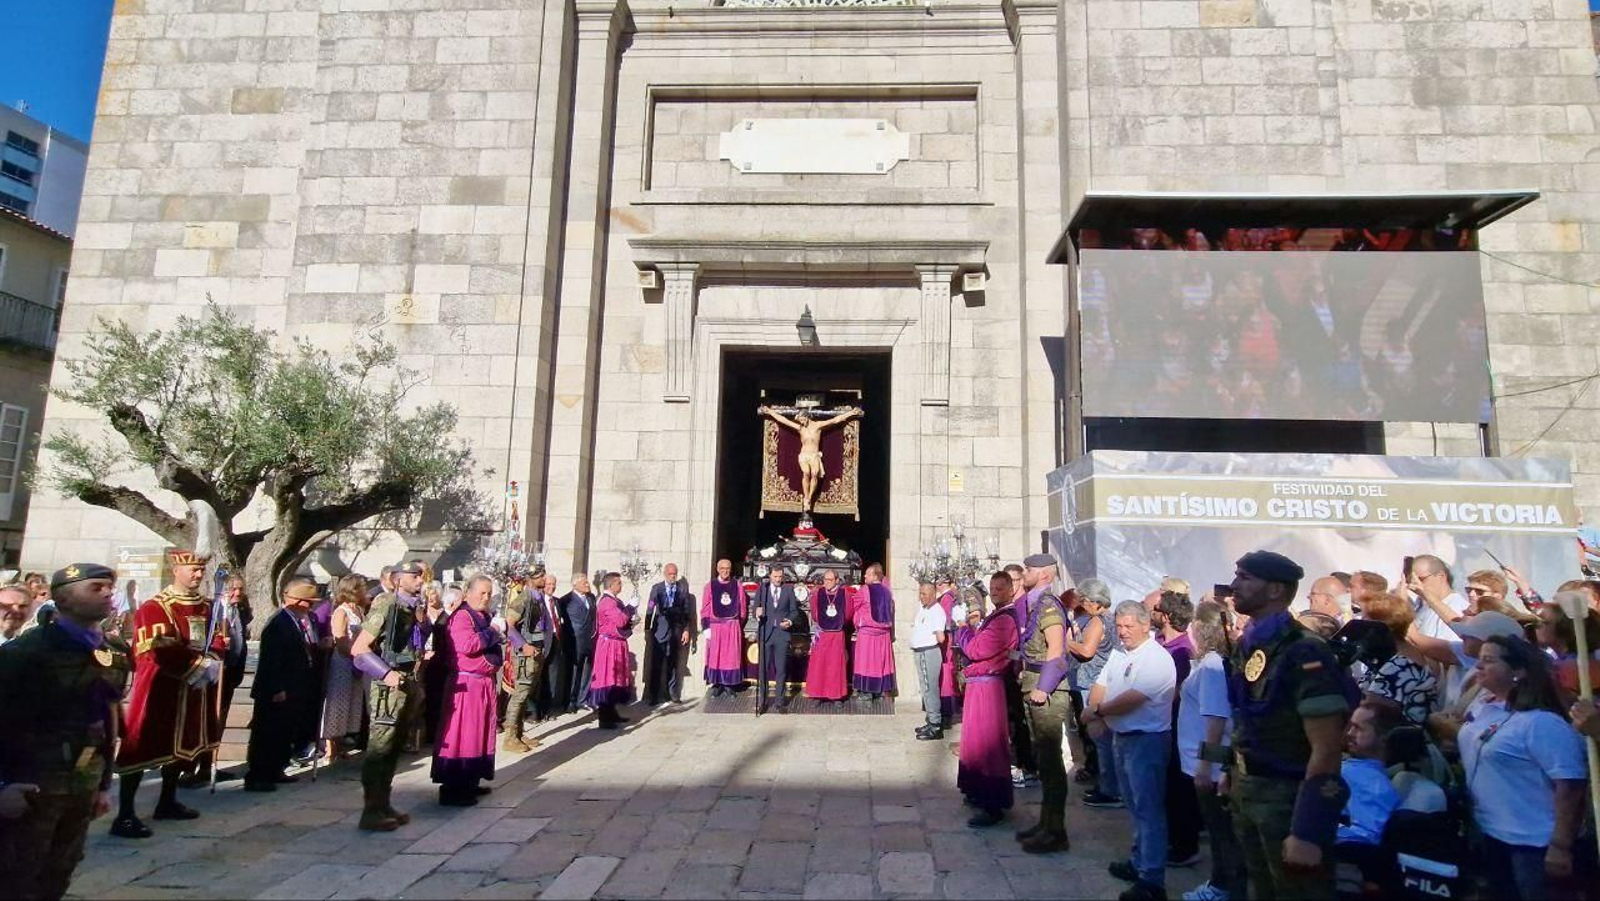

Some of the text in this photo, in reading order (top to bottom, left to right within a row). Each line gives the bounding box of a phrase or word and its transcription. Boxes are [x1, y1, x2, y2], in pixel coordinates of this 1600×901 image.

[1273, 483, 1388, 497] FESTIVIDAD DEL
[1107, 491, 1563, 524] SANTÍSIMO CRISTO DE LA VICTORIA
[1404, 876, 1451, 898] FILA
